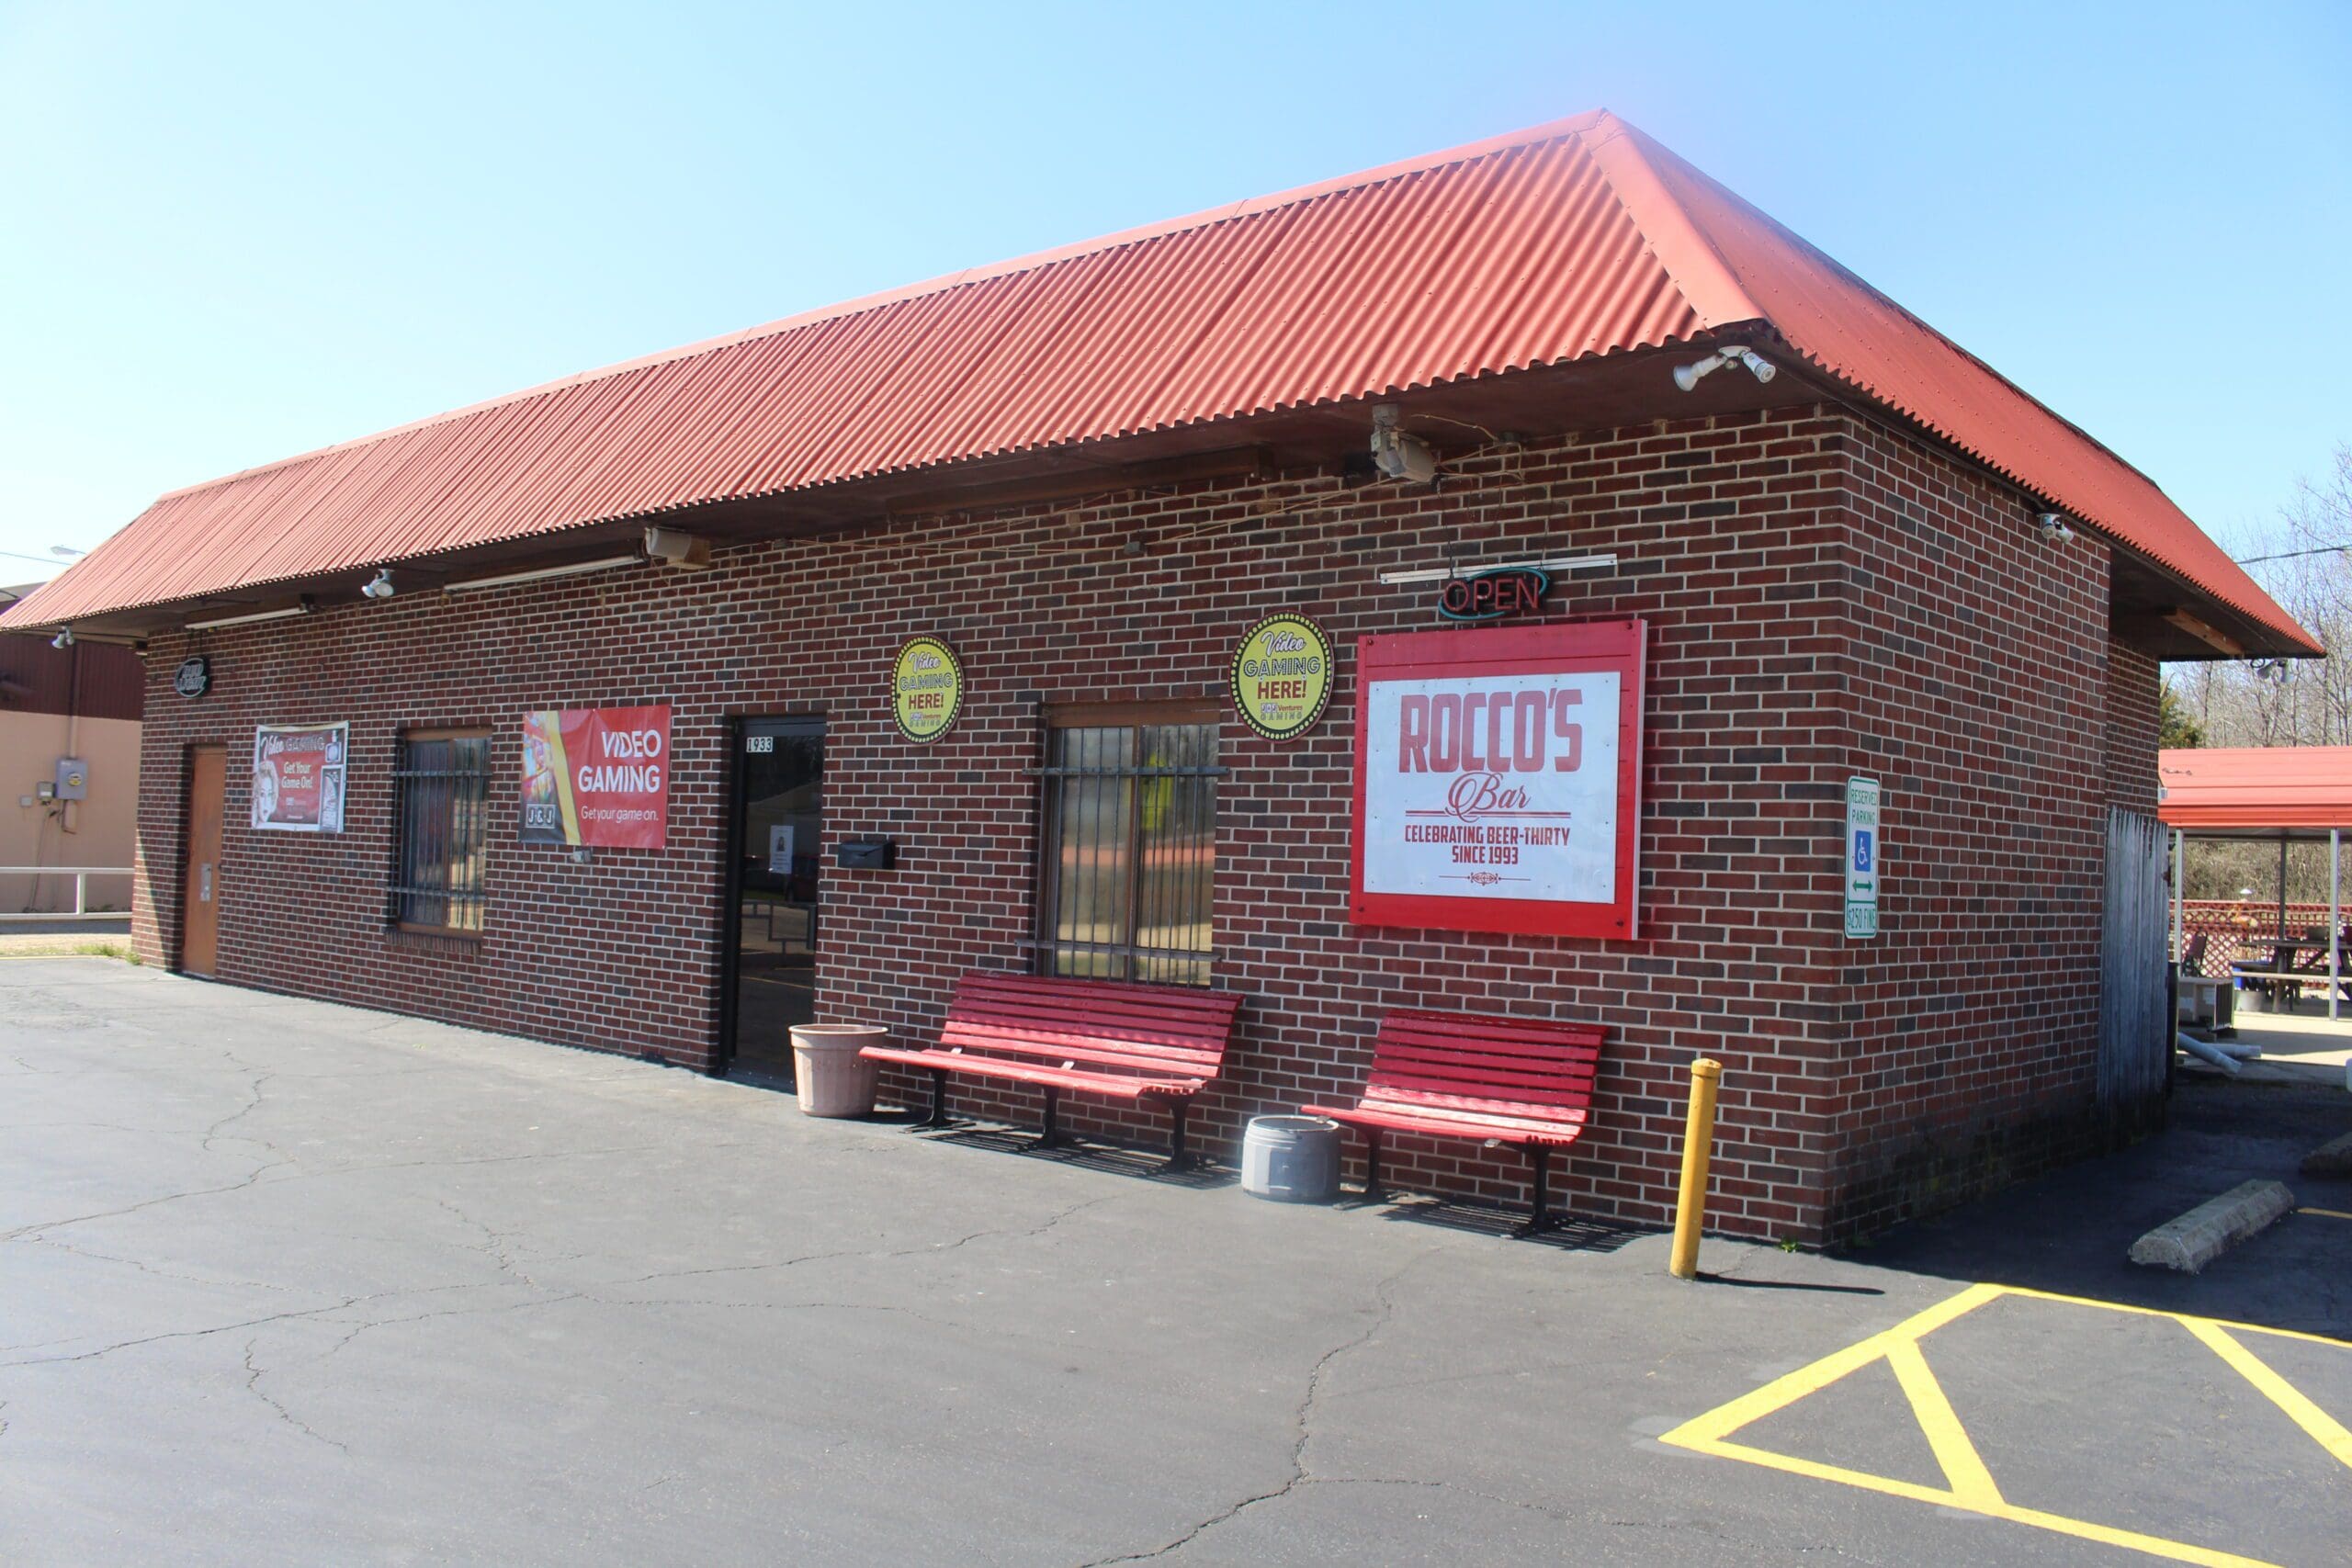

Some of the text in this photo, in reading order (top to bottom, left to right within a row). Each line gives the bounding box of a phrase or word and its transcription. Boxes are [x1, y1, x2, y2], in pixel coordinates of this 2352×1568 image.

[1442, 576, 1541, 611] OPEN
[1261, 631, 1306, 657] Video
[908, 651, 942, 673] Video
[1243, 656, 1320, 677] GAMING
[899, 672, 953, 691] GAMING
[1257, 681, 1307, 699] HERE!
[908, 693, 944, 709] HERE!
[1261, 711, 1303, 720] GAMING
[1398, 688, 1583, 773] ROCCO'S
[260, 735, 325, 761] Video GAMING
[602, 729, 662, 758] VIDEO
[747, 738, 773, 752] 1933
[284, 761, 311, 774] Get Your
[281, 776, 313, 788] Game On!
[578, 764, 661, 793] GAMING
[1445, 772, 1532, 823] Bar
[1850, 789, 1877, 806] RESERVED
[581, 806, 659, 823] Get your game on.
[1851, 809, 1875, 825] PARKING
[1405, 825, 1570, 846] CELEBRATING BEER-THIRTY
[1452, 846, 1519, 864] SINCE 1993
[1847, 908, 1876, 929] $250 FINE
